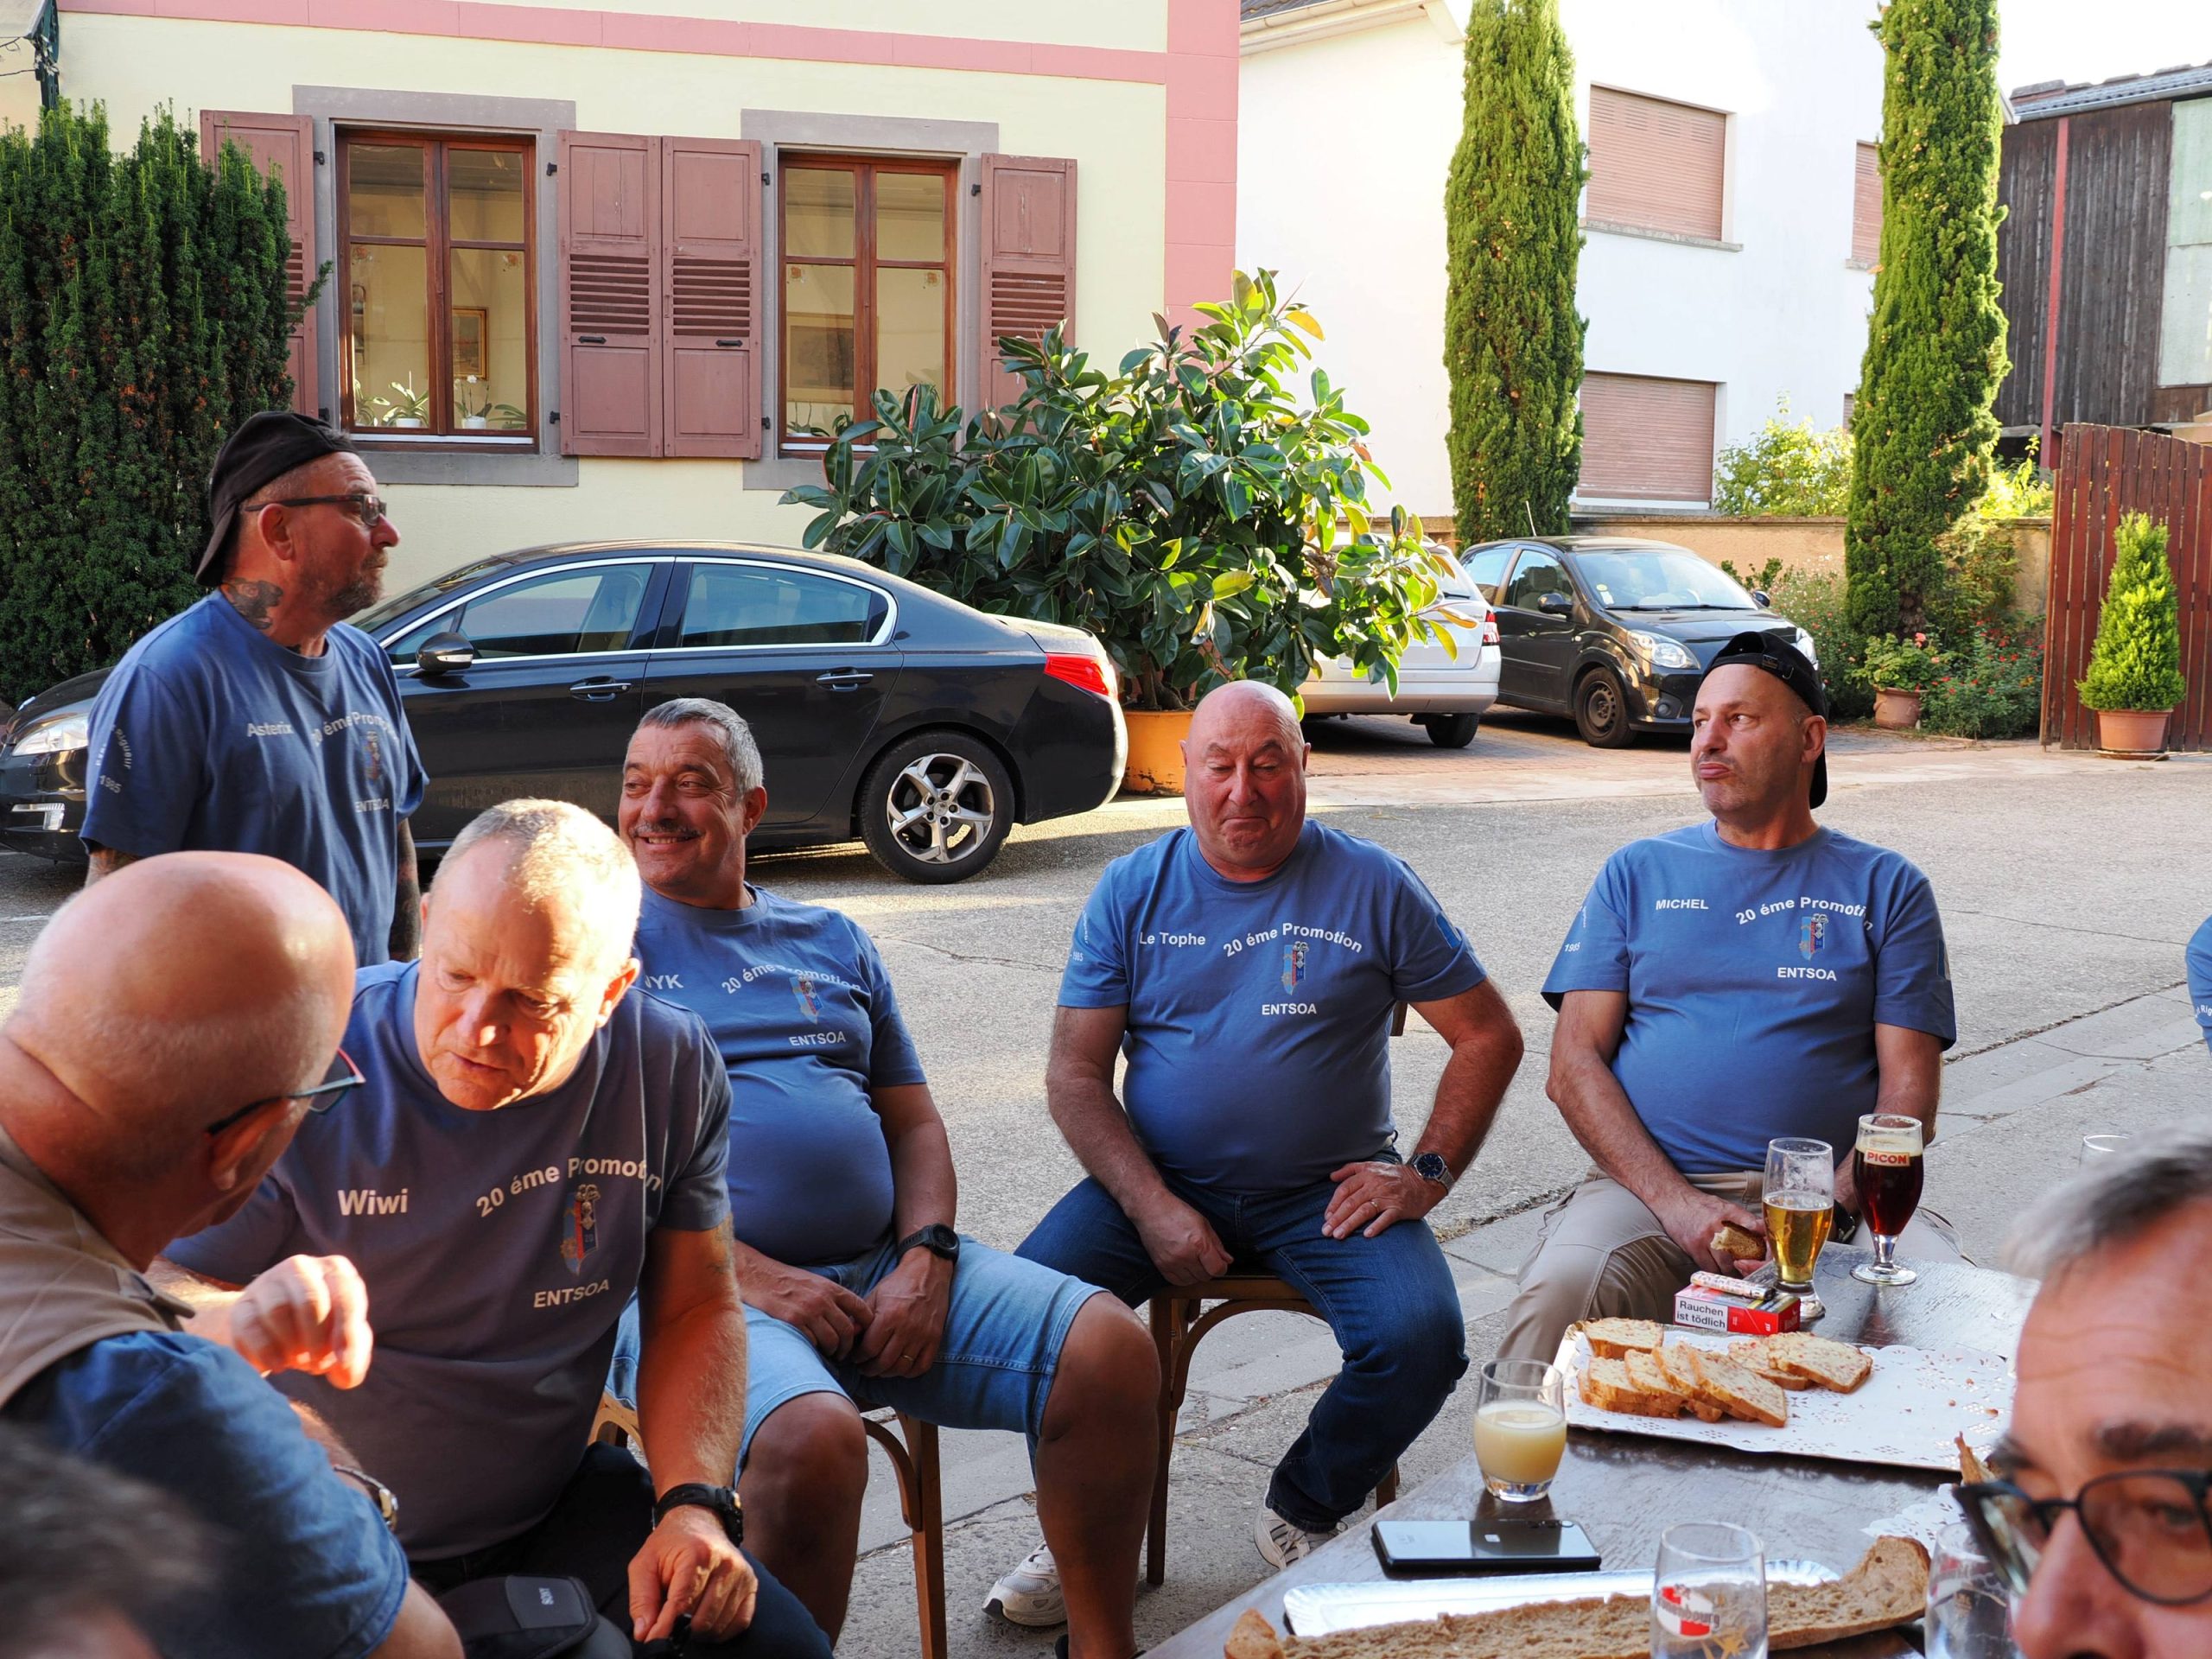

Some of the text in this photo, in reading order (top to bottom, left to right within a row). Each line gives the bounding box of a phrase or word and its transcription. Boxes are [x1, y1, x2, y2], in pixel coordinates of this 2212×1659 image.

[246, 721, 294, 738] Asterix
[1655, 898, 1709, 911] MICHEL
[1735, 896, 1874, 931] 20 éme Promotin
[1139, 931, 1206, 949] Le Tophe
[1223, 922, 1363, 957] 20 éme Promotion
[721, 977, 742, 995] 20
[776, 963, 862, 991] omotion
[1777, 967, 1837, 982] ENTSOA
[1262, 1002, 1318, 1016] ENTSOA
[788, 1031, 847, 1046] ENTSOA
[1866, 1151, 1907, 1165] PICON
[476, 1157, 662, 1217] 20 éme Promotn
[337, 1188, 410, 1216] Wiwi
[533, 1278, 610, 1308] ENTSOA
[1679, 1300, 1724, 1317] Rauchen
[1676, 1313, 1689, 1322] ist
[1691, 1313, 1726, 1329] tödlich
